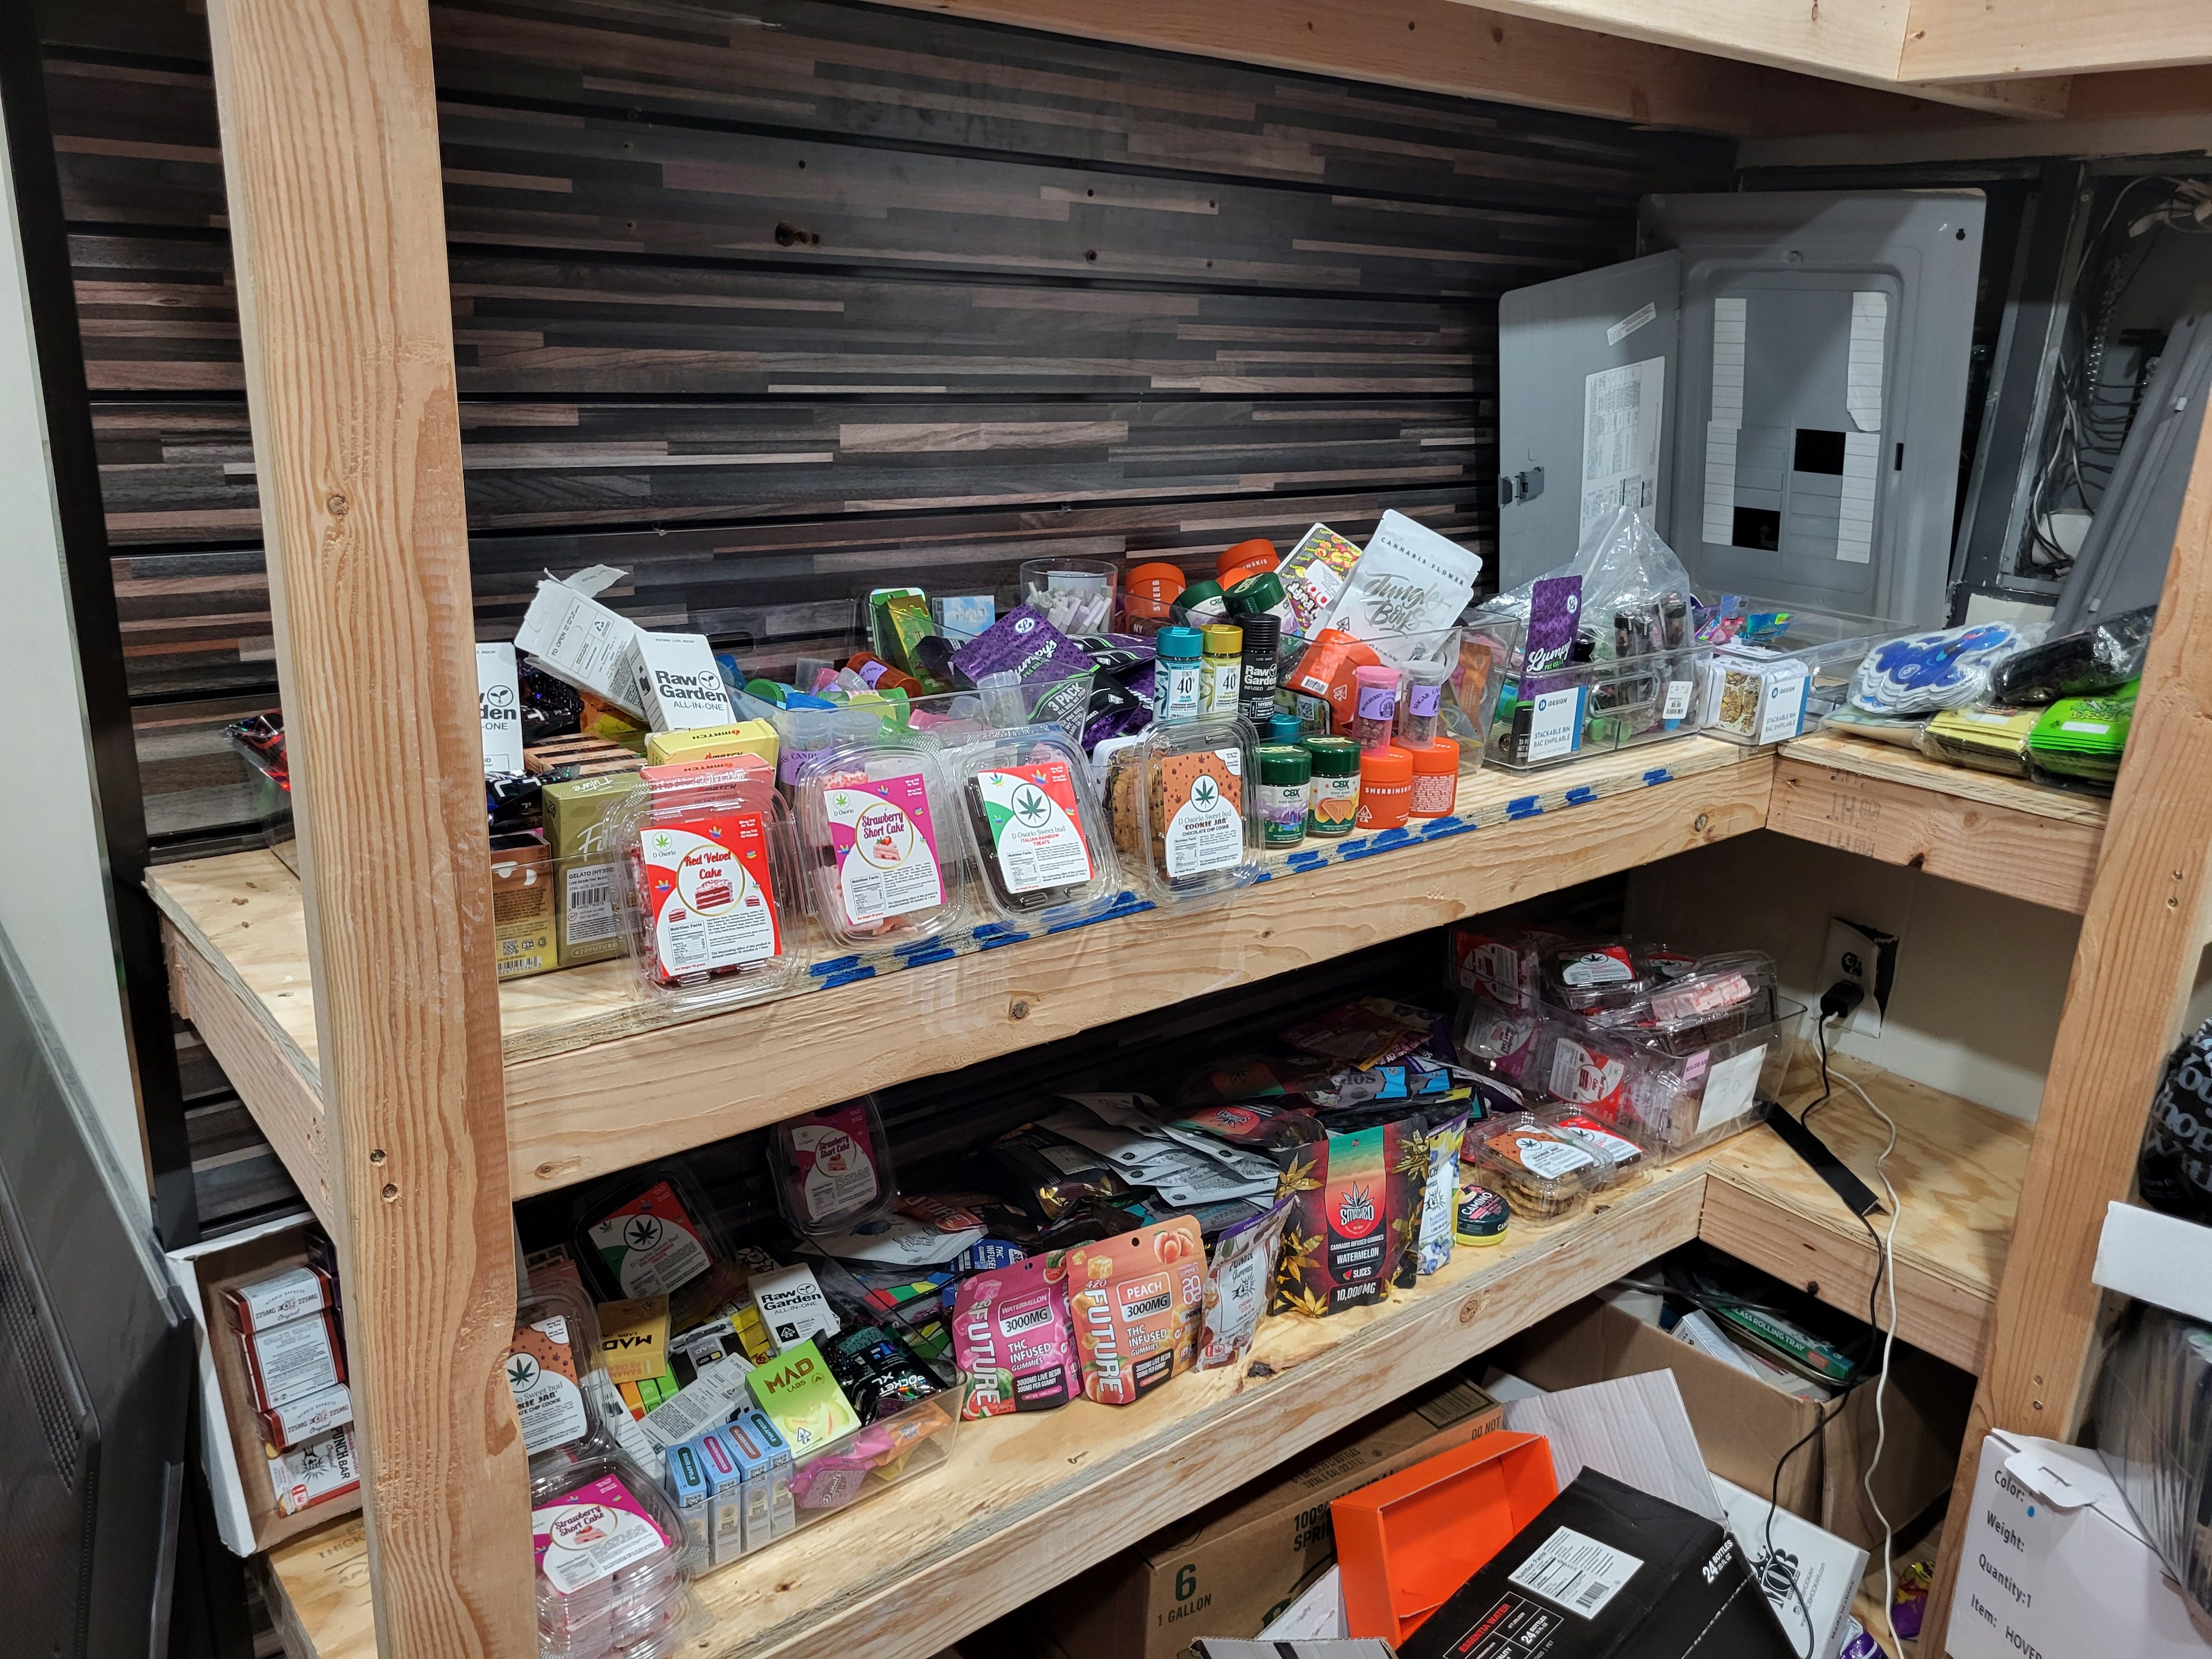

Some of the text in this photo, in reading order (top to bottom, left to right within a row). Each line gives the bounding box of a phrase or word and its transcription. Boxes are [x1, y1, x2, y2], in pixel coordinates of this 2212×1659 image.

[1381, 537, 1464, 586] CANNABIS FLOWER
[556, 632, 566, 649] OPEN
[655, 670, 697, 686] Raw
[1245, 665, 1270, 676] Raw
[1244, 675, 1277, 685] Garden
[660, 684, 728, 703] Garden
[1047, 682, 1083, 712] 3 PACK
[1413, 693, 1430, 709] SUGAR
[673, 701, 725, 711] ALL-IN-ONE
[1361, 693, 1384, 712] BLUEBERRY
[1766, 713, 1788, 724] STACKABLE
[1535, 727, 1562, 739] STACKABLE
[1544, 734, 1570, 745] EMPILABLE
[1283, 788, 1300, 797] CBX
[1333, 780, 1350, 789] CBX
[862, 812, 903, 827] Strawberry
[1184, 814, 1203, 824] Osorio
[1204, 812, 1220, 821] Sweet
[1220, 808, 1232, 818] bud
[864, 823, 904, 839] Short Cake
[1018, 829, 1036, 838] Osorio
[1037, 827, 1053, 836] Sweet
[1054, 825, 1066, 833] bud
[1182, 828, 1206, 837] CHOCOLATE
[1021, 836, 1037, 844] ITALIAN
[684, 851, 732, 867] Red Velvet
[569, 870, 591, 879] GELATO
[699, 868, 722, 879] Cake
[575, 942, 618, 956] 420FUTURE
[1686, 1059, 1708, 1072] REGULAR
[818, 1134, 849, 1151] Strawberry
[820, 1142, 850, 1159] Short Cake
[1462, 1191, 1493, 1216] CAMINO
[1331, 1234, 1384, 1251] CANNABIS INFUSED GUMMIES
[995, 1245, 1004, 1259] THC
[1337, 1247, 1379, 1265] WATERMELON
[1178, 1261, 1198, 1271] PREMIUM
[1179, 1266, 1199, 1277] GUMMIES
[1353, 1266, 1371, 1279] SLICES
[761, 1289, 796, 1304] Raw
[1126, 1280, 1162, 1299] PEACH
[1337, 1282, 1376, 1302] 10,000MG
[265, 1295, 283, 1305] HYBRID
[298, 1293, 318, 1305] 225MG
[764, 1292, 822, 1311] Garden
[1001, 1294, 1047, 1314] WATERMELON
[1126, 1296, 1168, 1318] 3000MG
[255, 1308, 276, 1319] 225MG
[278, 1308, 300, 1321] Original
[774, 1300, 818, 1315] ALL-IN-ONE
[1241, 1303, 1251, 1313] COLA
[796, 1317, 816, 1326] INDICA
[1005, 1308, 1048, 1333] 3000MG
[1731, 1303, 1806, 1352] GLASS ROLLING TRAY
[1083, 1279, 1124, 1395] 420 FUTURE
[1126, 1324, 1145, 1338] THC
[1128, 1328, 1167, 1348] INFUSED
[602, 1334, 653, 1351] MAD
[1008, 1339, 1027, 1353] THC
[1131, 1342, 1159, 1357] GUMMIES
[968, 1300, 1001, 1406] 420 FUTURE
[1009, 1342, 1051, 1364] INFUSED
[1011, 1356, 1044, 1372] GUMMIES
[1135, 1352, 1171, 1371] 3000MG LIVE RESIN
[763, 1357, 814, 1394] MAD
[872, 1371, 895, 1385] XL
[1016, 1367, 1061, 1387] 3000MG LIVE RESIN
[1136, 1370, 1149, 1379] 300MG
[1155, 1361, 1166, 1373] GUMMY
[524, 1381, 563, 1400] Sweet bud
[787, 1379, 807, 1393] LABS
[1017, 1378, 1056, 1394] 300MG PER GUMMY
[329, 1405, 349, 1417] 225MG
[529, 1404, 541, 1412] CHIP
[542, 1397, 561, 1408] COOKIE
[297, 1407, 314, 1420] HYBRID
[288, 1421, 307, 1433] 225MG
[309, 1420, 331, 1434] Original
[764, 1427, 778, 1443] APPLE
[1472, 1416, 1501, 1440] DO NOT
[332, 1426, 350, 1480] PUNCH BAR
[1301, 1448, 1361, 1479] GAL BOTTLES
[686, 1465, 696, 1481] APPLE
[1304, 1460, 1358, 1489] TOTAL GAL (22.71
[1994, 1469, 2025, 1503] Color:
[554, 1505, 602, 1530] Strawberry
[559, 1511, 605, 1537] Short Cake
[1294, 1501, 1329, 1531] 100%
[1986, 1510, 2025, 1553] Weight:
[1516, 1551, 1547, 1580] Nutrition Facts
[1702, 1538, 1733, 1584] 24 BOTTLES
[1725, 1553, 1732, 1562] OZ
[1175, 1563, 1197, 1601] 6
[1978, 1553, 2032, 1609] Quantity:1
[1159, 1593, 1212, 1626] 1 GALLON
[1831, 1617, 1842, 1639] Made
[1844, 1580, 1855, 1604] china
[1970, 1593, 1997, 1628] Item:
[1458, 1621, 1490, 1654] ESSENTIA
[1487, 1603, 1512, 1628] WATER
[1521, 1615, 1547, 1645] 24 BOTTLES
